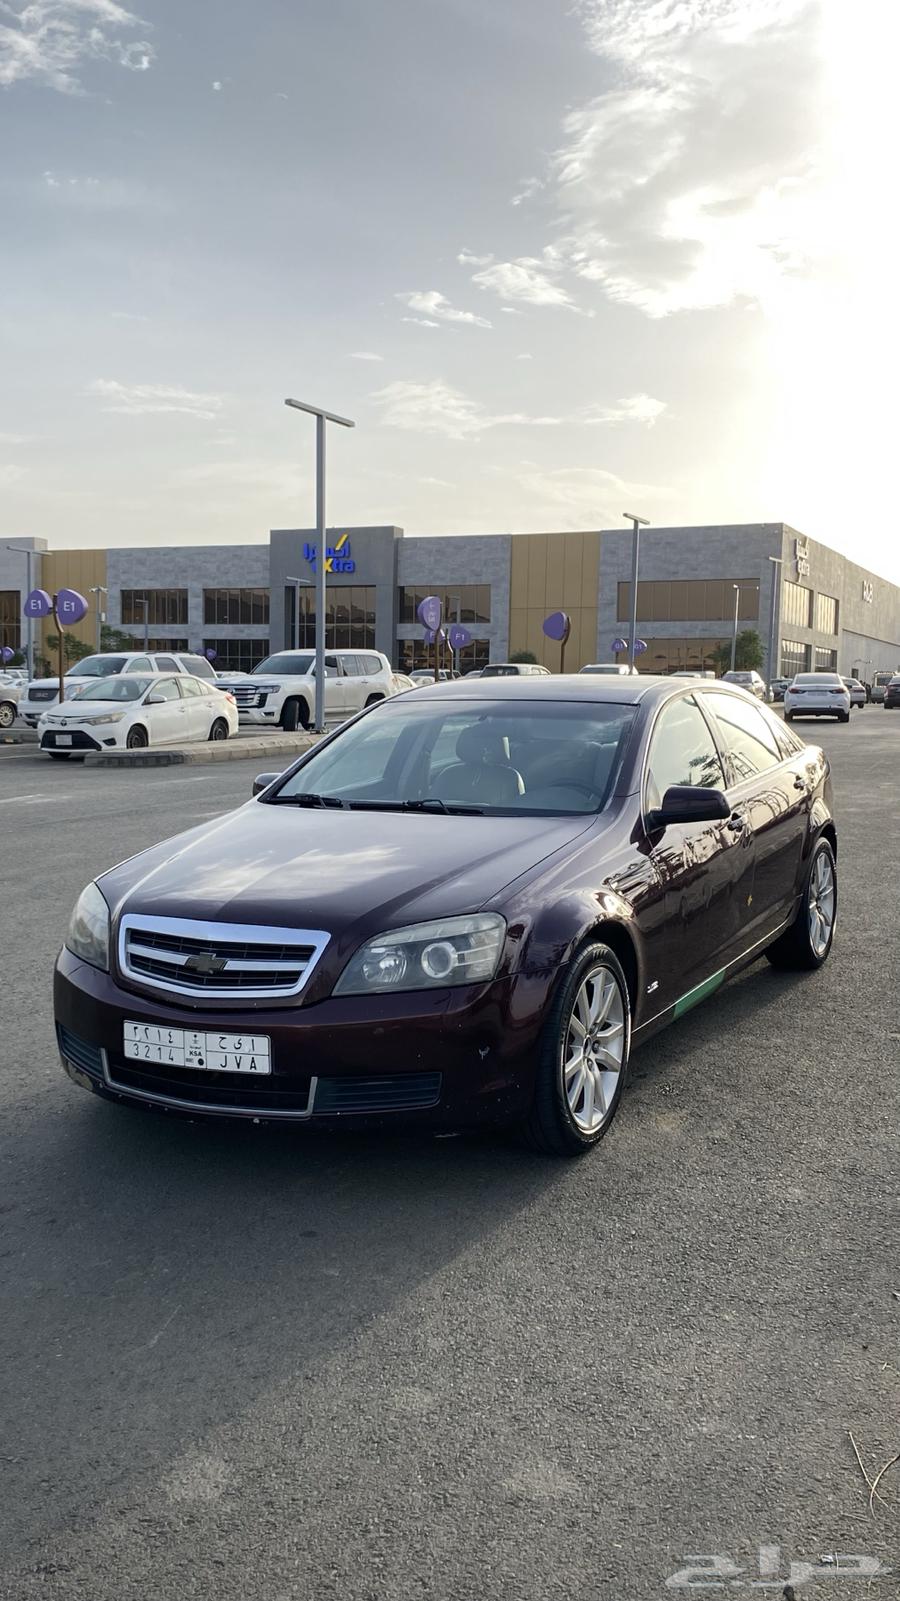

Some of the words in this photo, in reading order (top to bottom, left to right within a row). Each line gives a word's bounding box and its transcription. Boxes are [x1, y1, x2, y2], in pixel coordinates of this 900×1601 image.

[30, 599, 42, 610] E1
[63, 600, 75, 612] E1
[455, 632, 465, 641] F1
[133, 1043, 174, 1062] 3214
[220, 1055, 257, 1071] JVA
